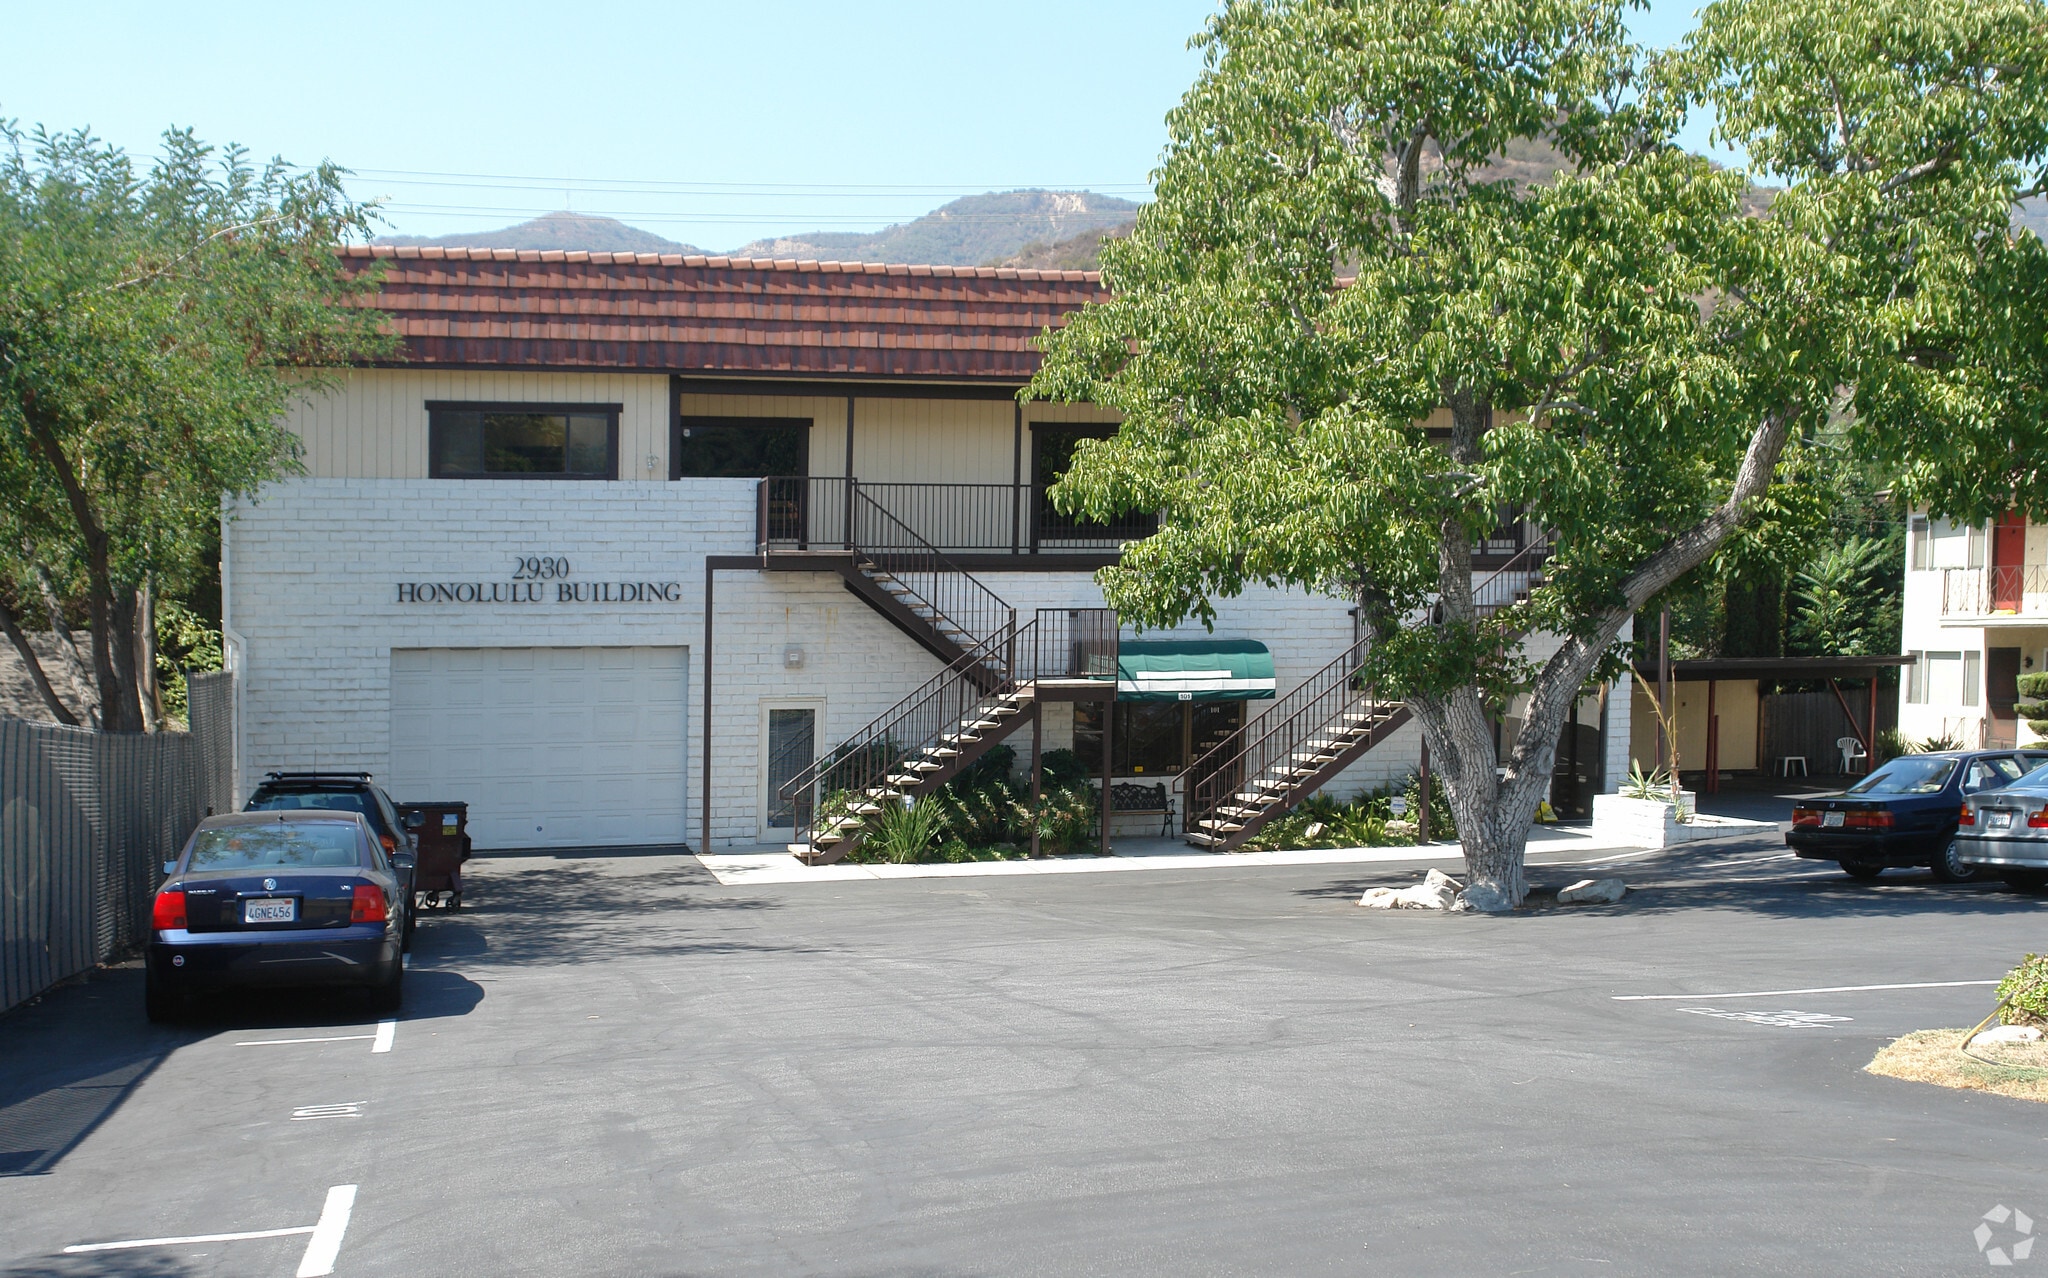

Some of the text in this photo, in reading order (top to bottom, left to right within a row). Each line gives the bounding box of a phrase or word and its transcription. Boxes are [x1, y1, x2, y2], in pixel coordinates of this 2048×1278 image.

[512, 557, 570, 579] 2930
[397, 582, 682, 602] HONOLULU BUILDING
[248, 906, 291, 919] 4GNE456
